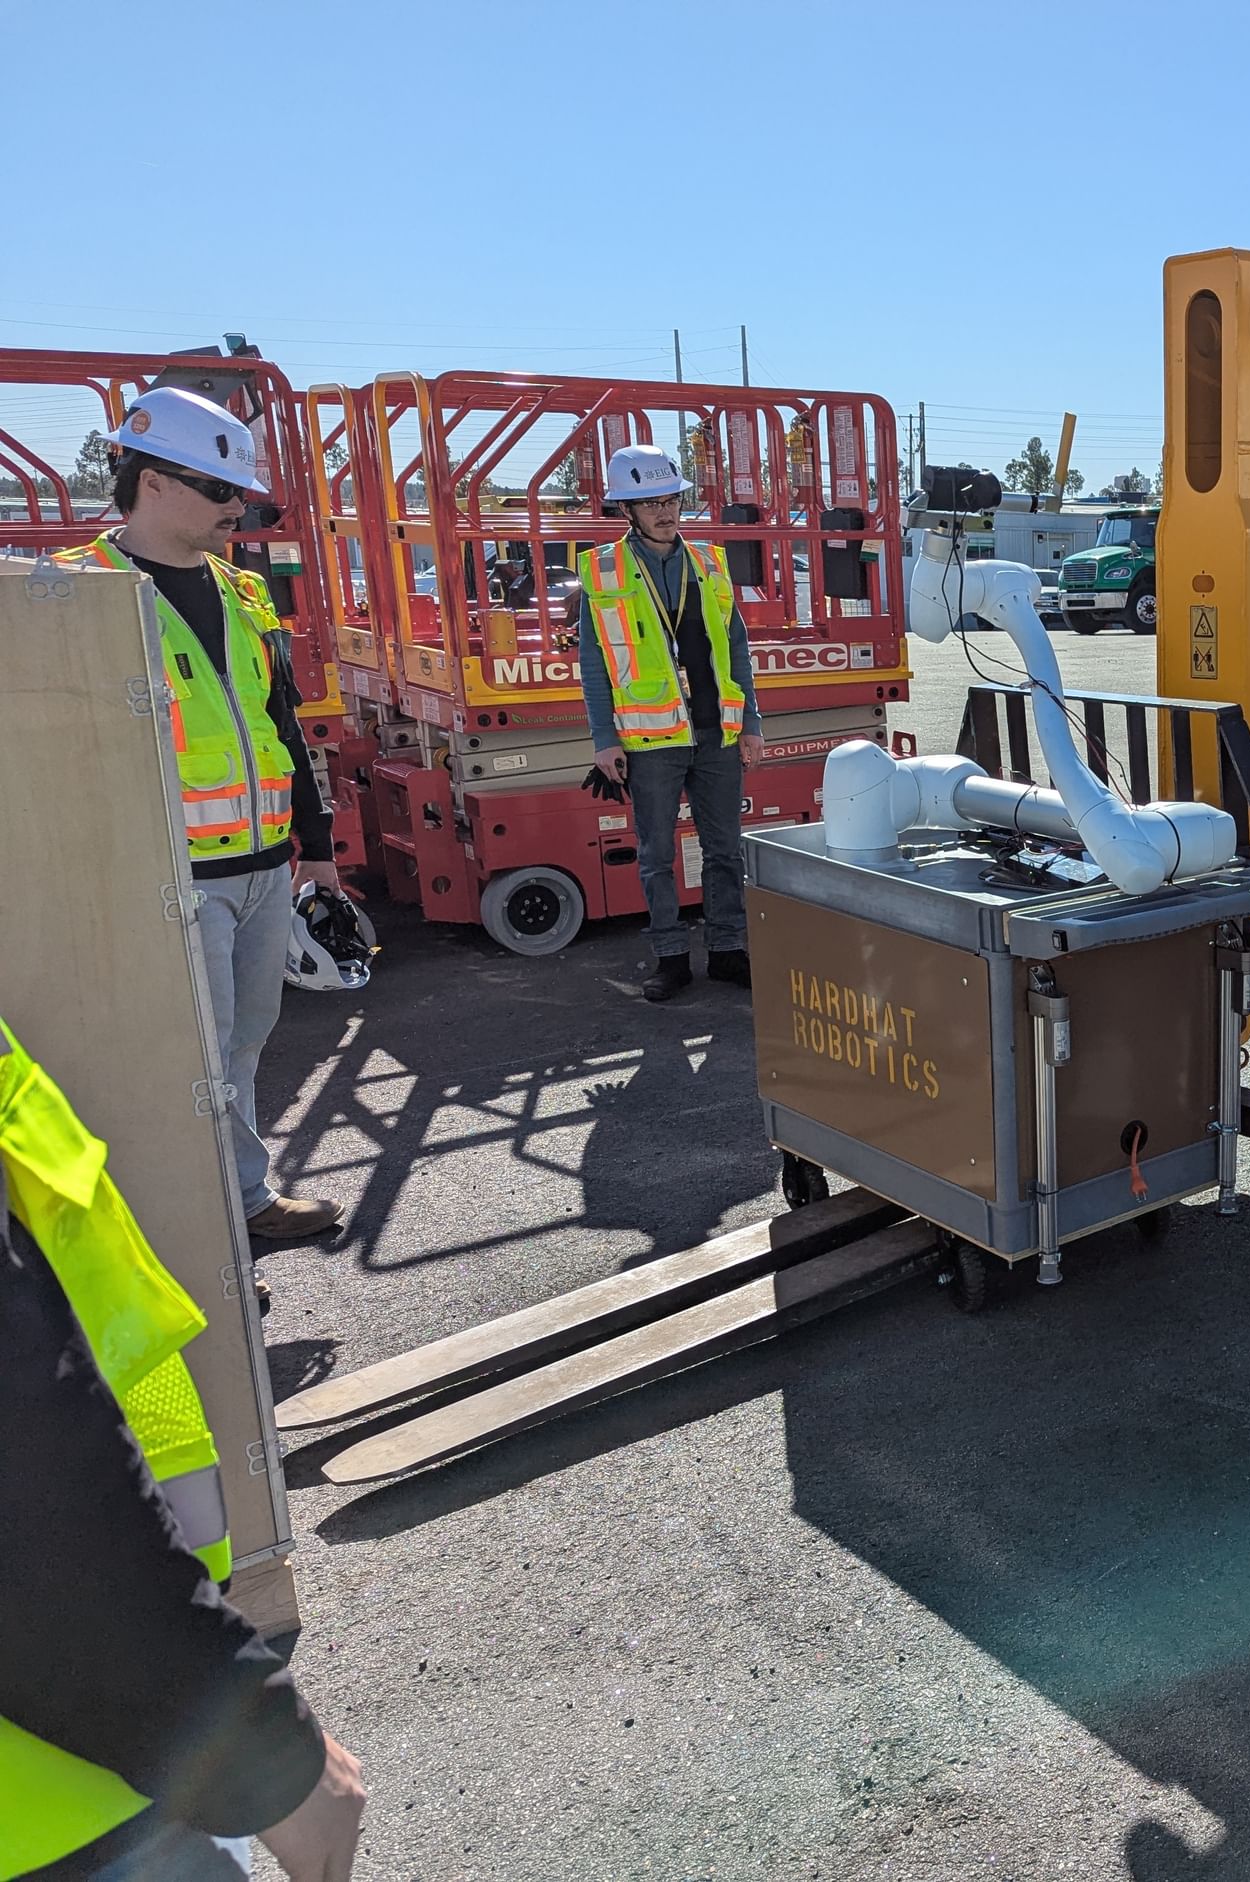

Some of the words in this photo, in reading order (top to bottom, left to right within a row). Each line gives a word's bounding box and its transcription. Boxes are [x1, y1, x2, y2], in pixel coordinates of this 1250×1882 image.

[751, 646, 846, 670] mec
[763, 738, 847, 758] EQUIPME
[790, 968, 916, 1047] HARDHAT
[793, 1010, 940, 1099] ROBOTICS
